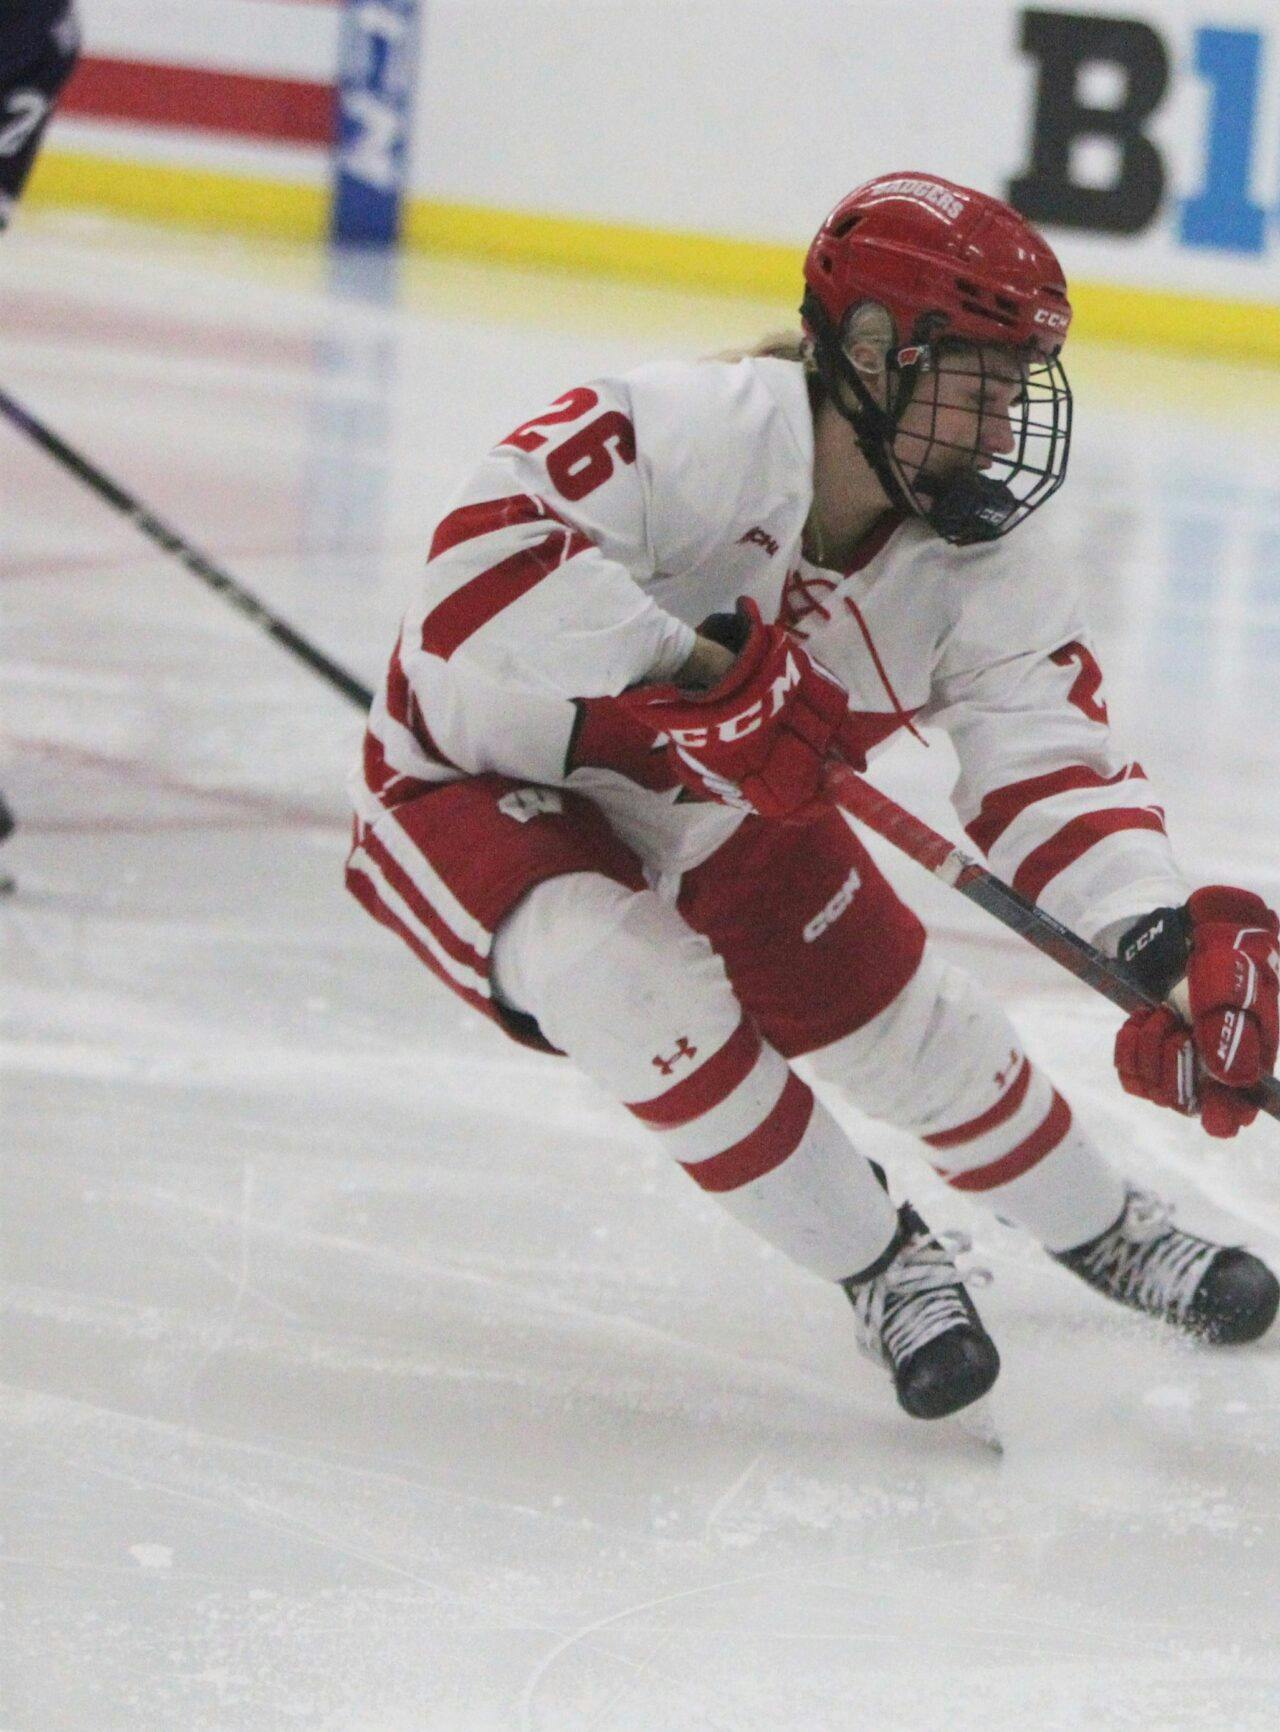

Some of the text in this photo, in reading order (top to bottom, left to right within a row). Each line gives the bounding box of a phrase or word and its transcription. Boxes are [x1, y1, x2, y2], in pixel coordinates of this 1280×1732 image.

[499, 386, 637, 502] 26
[653, 650, 801, 748] CCM
[1124, 919, 1164, 962] CCM
[1216, 1010, 1236, 1060] CCM
